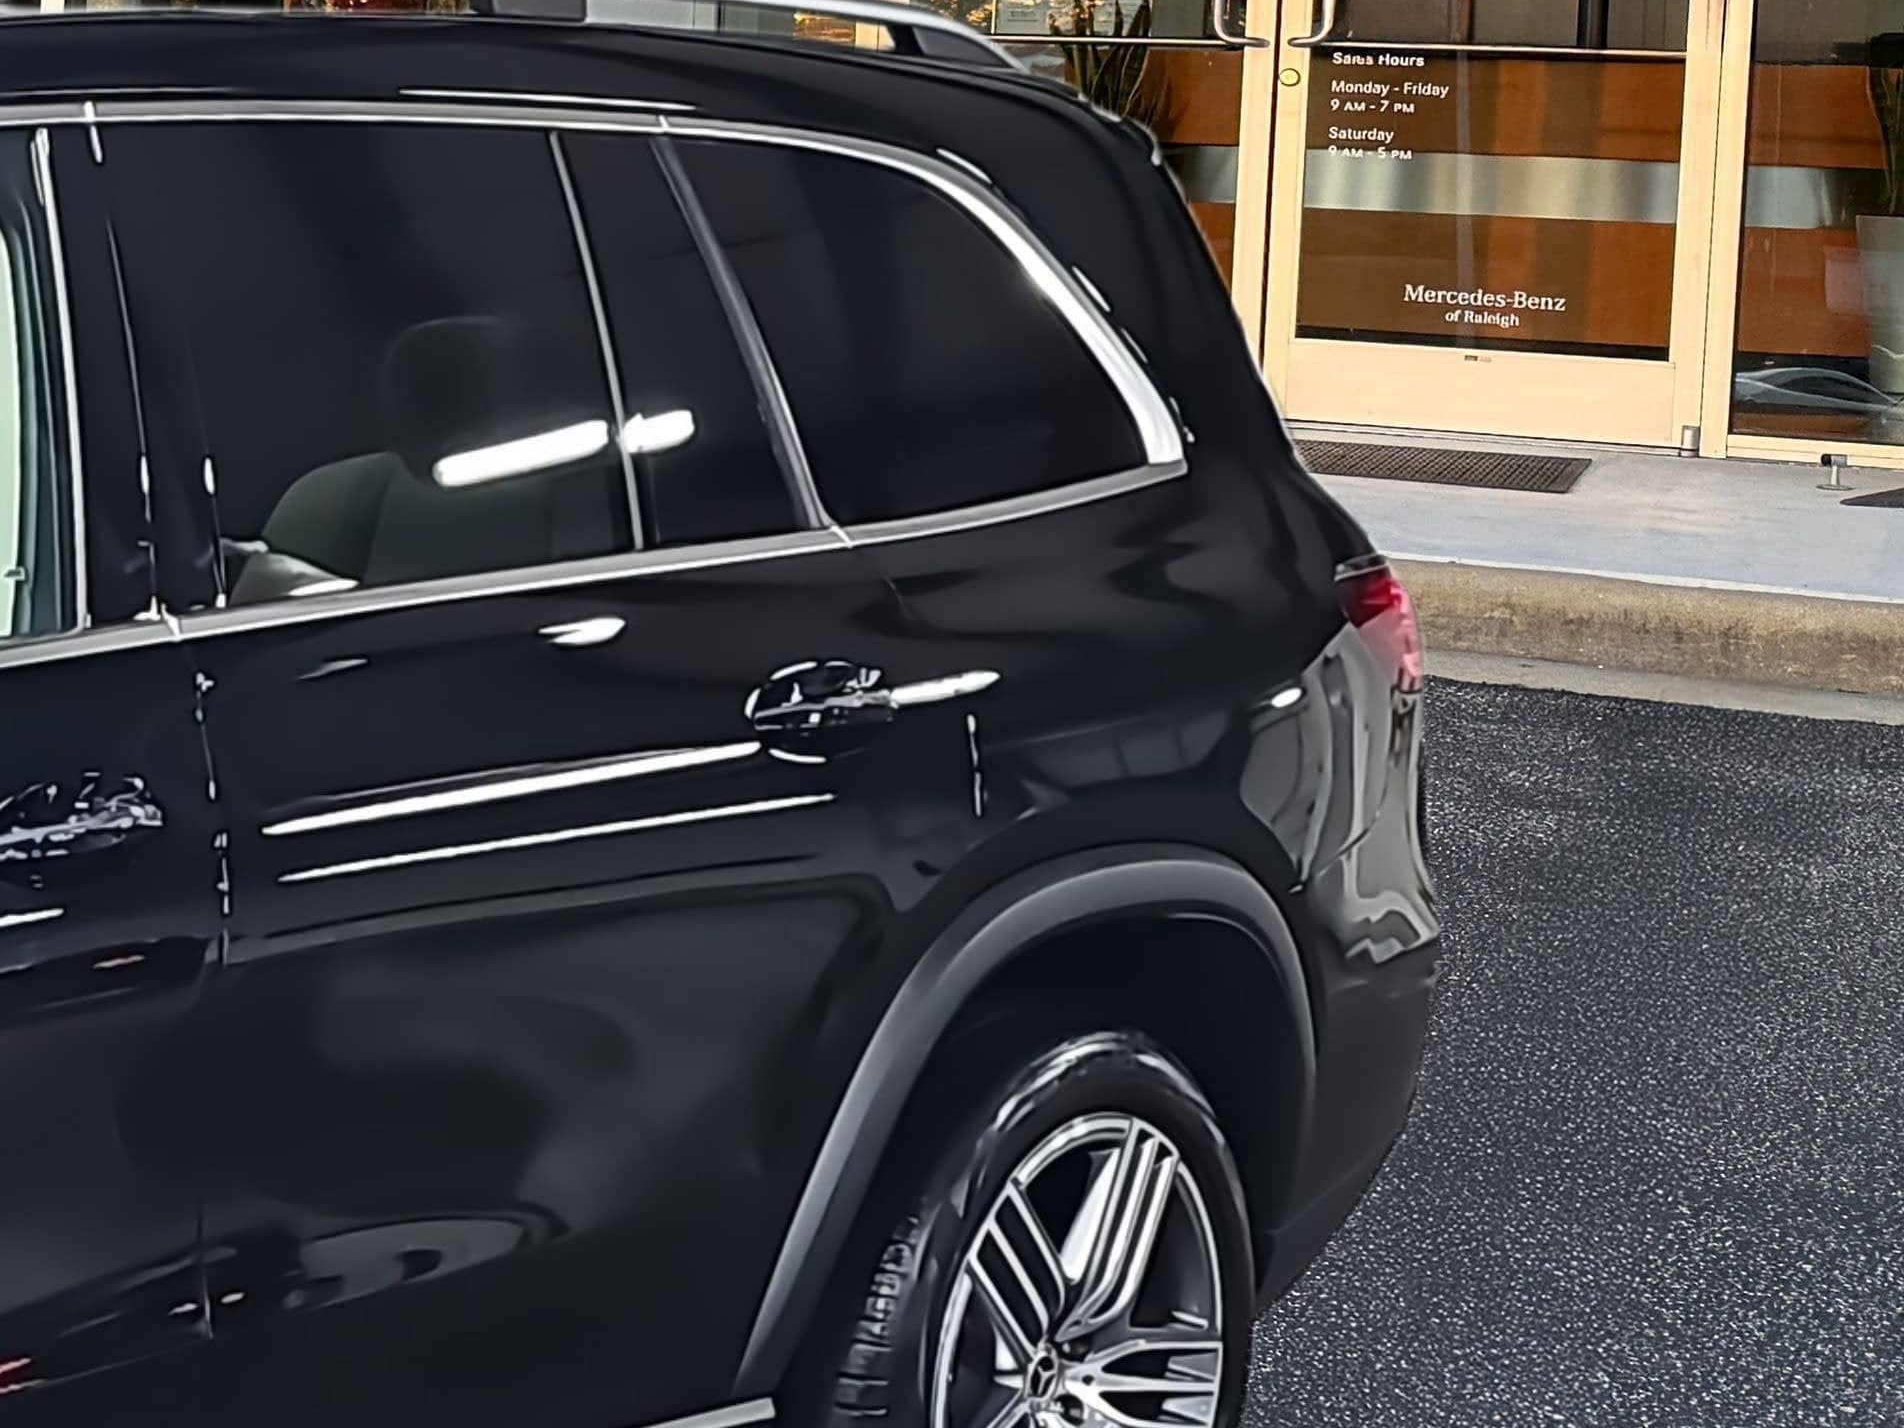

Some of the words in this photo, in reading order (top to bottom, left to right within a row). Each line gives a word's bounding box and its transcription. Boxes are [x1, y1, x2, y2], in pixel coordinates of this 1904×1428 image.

[1378, 53, 1425, 67] Hours
[1331, 80, 1390, 97] Monday
[1403, 82, 1449, 98] Friday
[1330, 98, 1340, 111] 9
[1344, 101, 1366, 112] AM
[1380, 100, 1390, 112] 7
[1393, 103, 1415, 113] PM
[1328, 126, 1394, 144] Saturday
[1328, 145, 1338, 158] 9
[1342, 148, 1364, 158] AM
[1377, 146, 1387, 159] 5
[1391, 150, 1413, 160] PM
[1403, 284, 1566, 312] Mercedes-Benz
[1445, 309, 1462, 322] of
[1464, 310, 1520, 328] Raleigh
